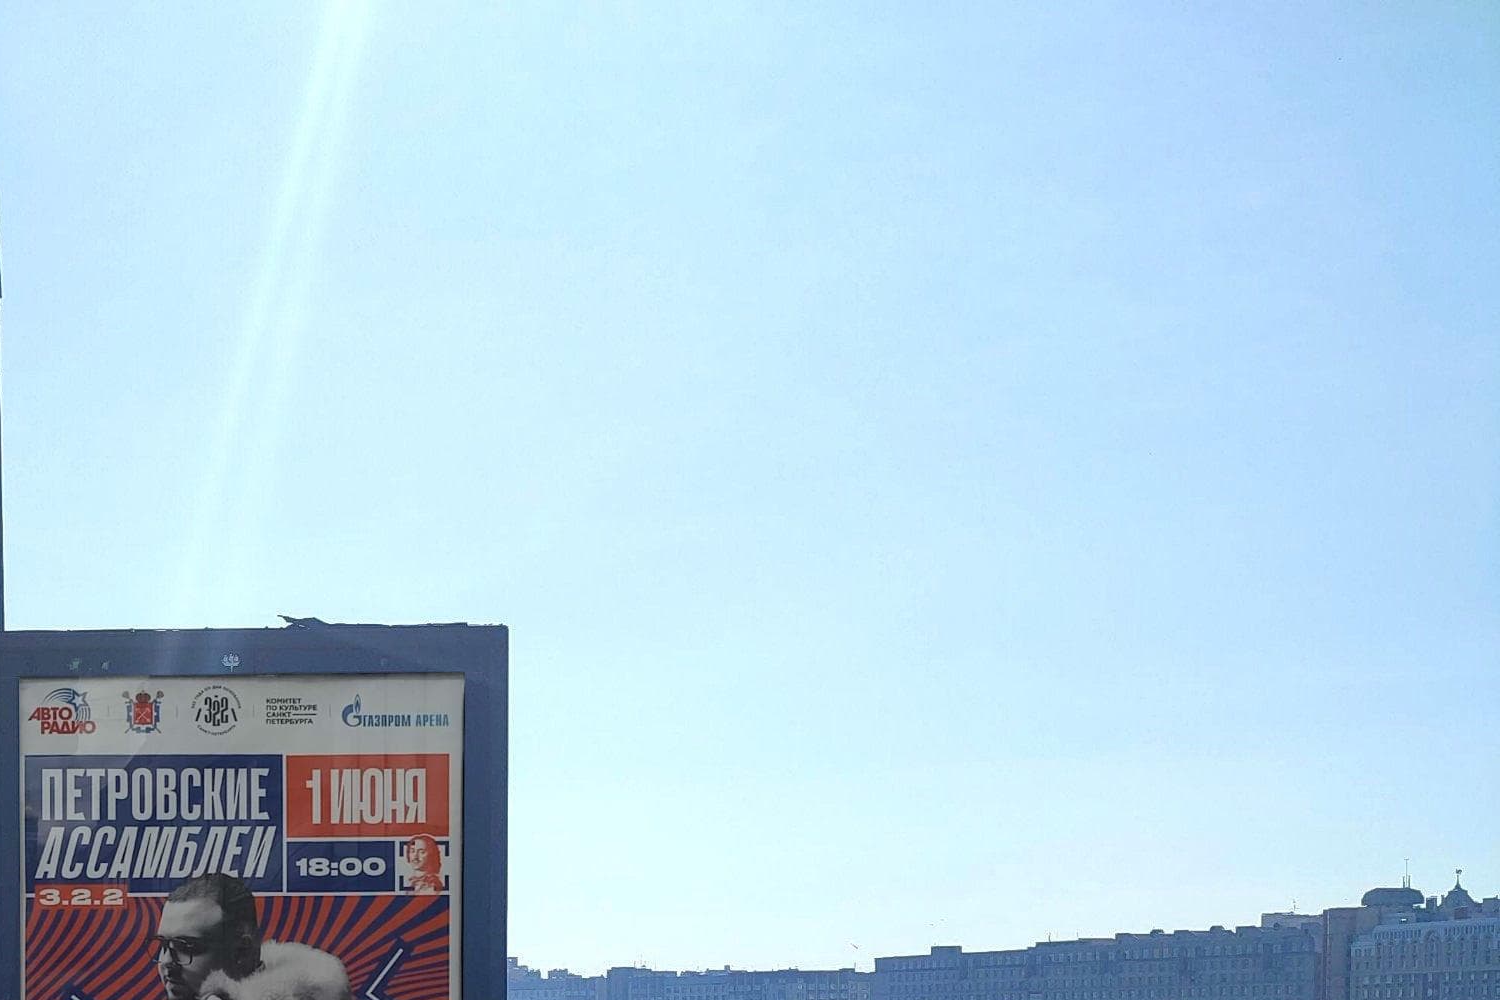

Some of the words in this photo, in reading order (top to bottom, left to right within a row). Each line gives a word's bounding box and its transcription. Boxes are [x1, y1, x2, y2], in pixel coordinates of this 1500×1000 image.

[28, 706, 73, 721] АВТО
[362, 714, 411, 727] ГАЗПРОМ
[415, 714, 449, 727] АРЕНА
[40, 720, 96, 735] РАДИО
[41, 767, 270, 821] ПЕТРОВСКИЕ
[306, 768, 321, 824] 1
[331, 768, 426, 824] ИЮНЯ
[34, 826, 278, 879] АССАМБЛЕИ
[295, 857, 386, 877] 18:00
[39, 888, 124, 906] 3.2.2
